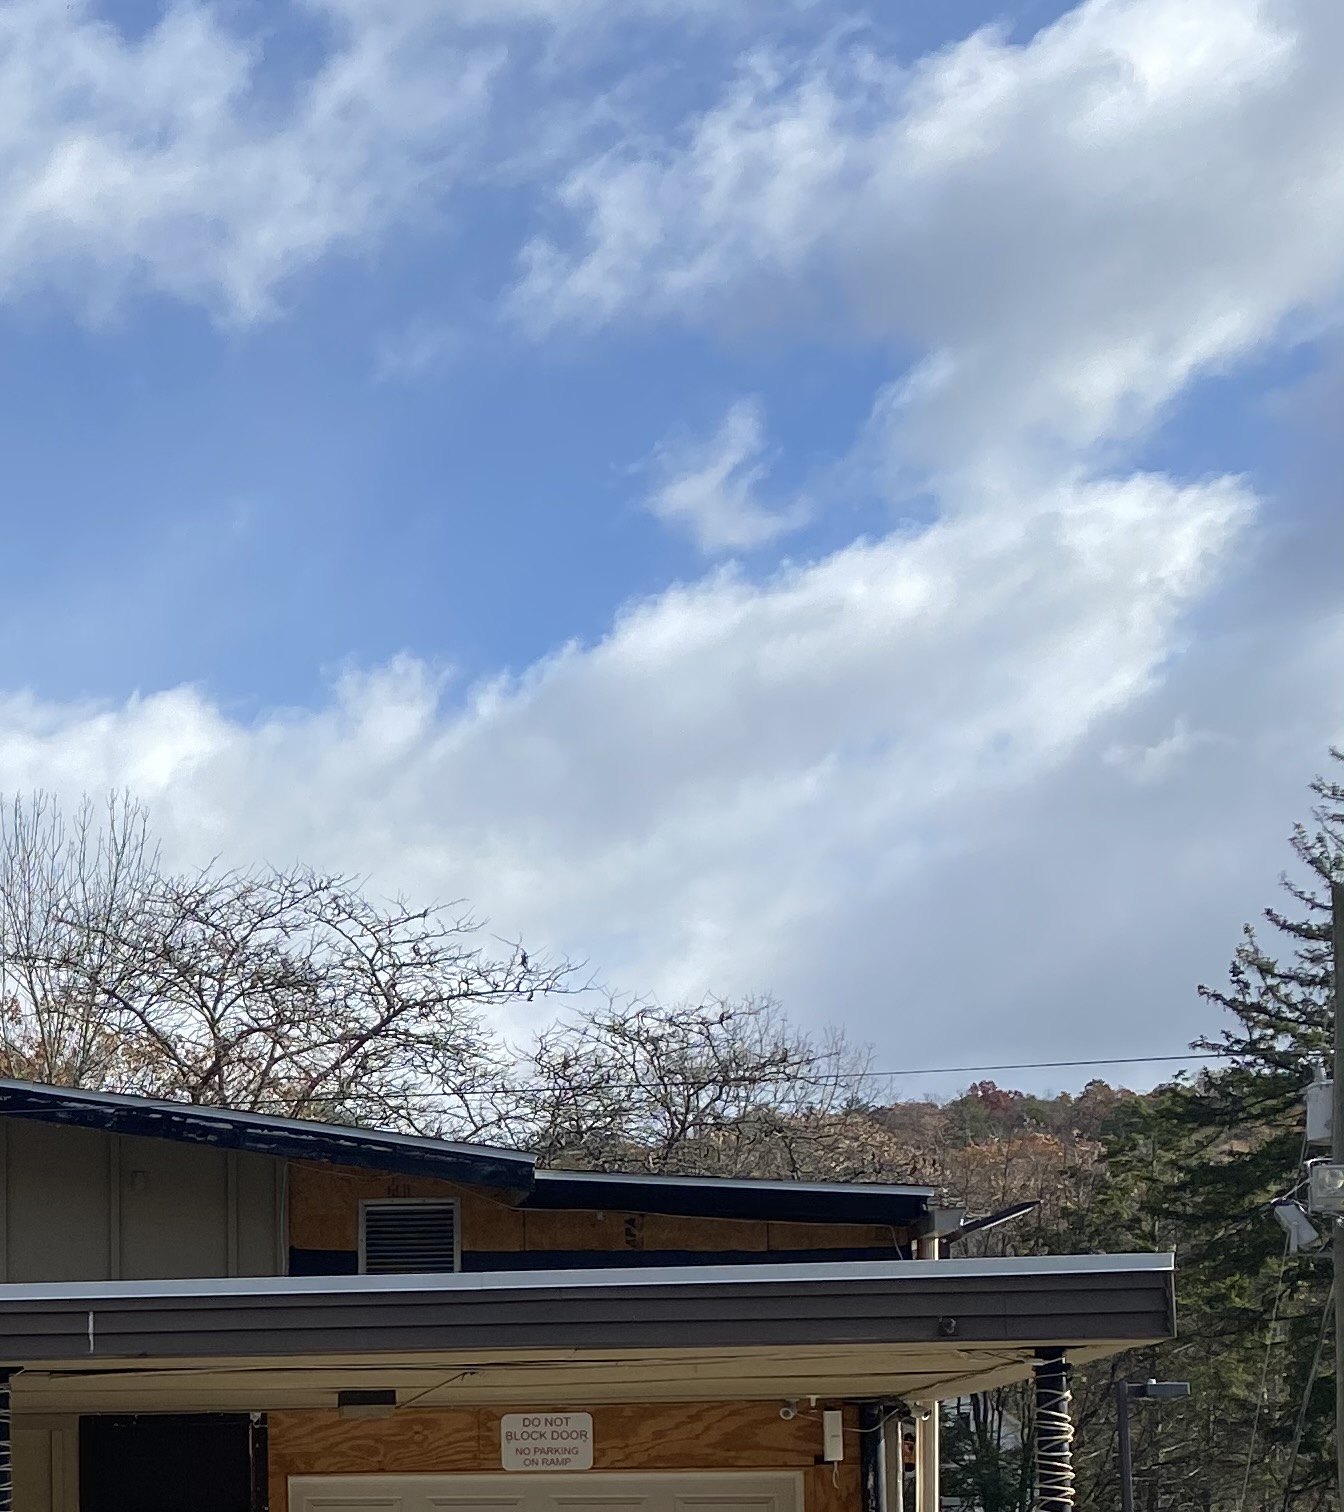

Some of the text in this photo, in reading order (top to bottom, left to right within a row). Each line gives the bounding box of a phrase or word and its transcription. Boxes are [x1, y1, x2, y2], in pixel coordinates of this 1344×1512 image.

[522, 1416, 571, 1427] DO NOT
[505, 1430, 588, 1441] BLOCK DOOR
[515, 1446, 579, 1456] NO PARKING
[523, 1457, 571, 1466] ON RAMP
